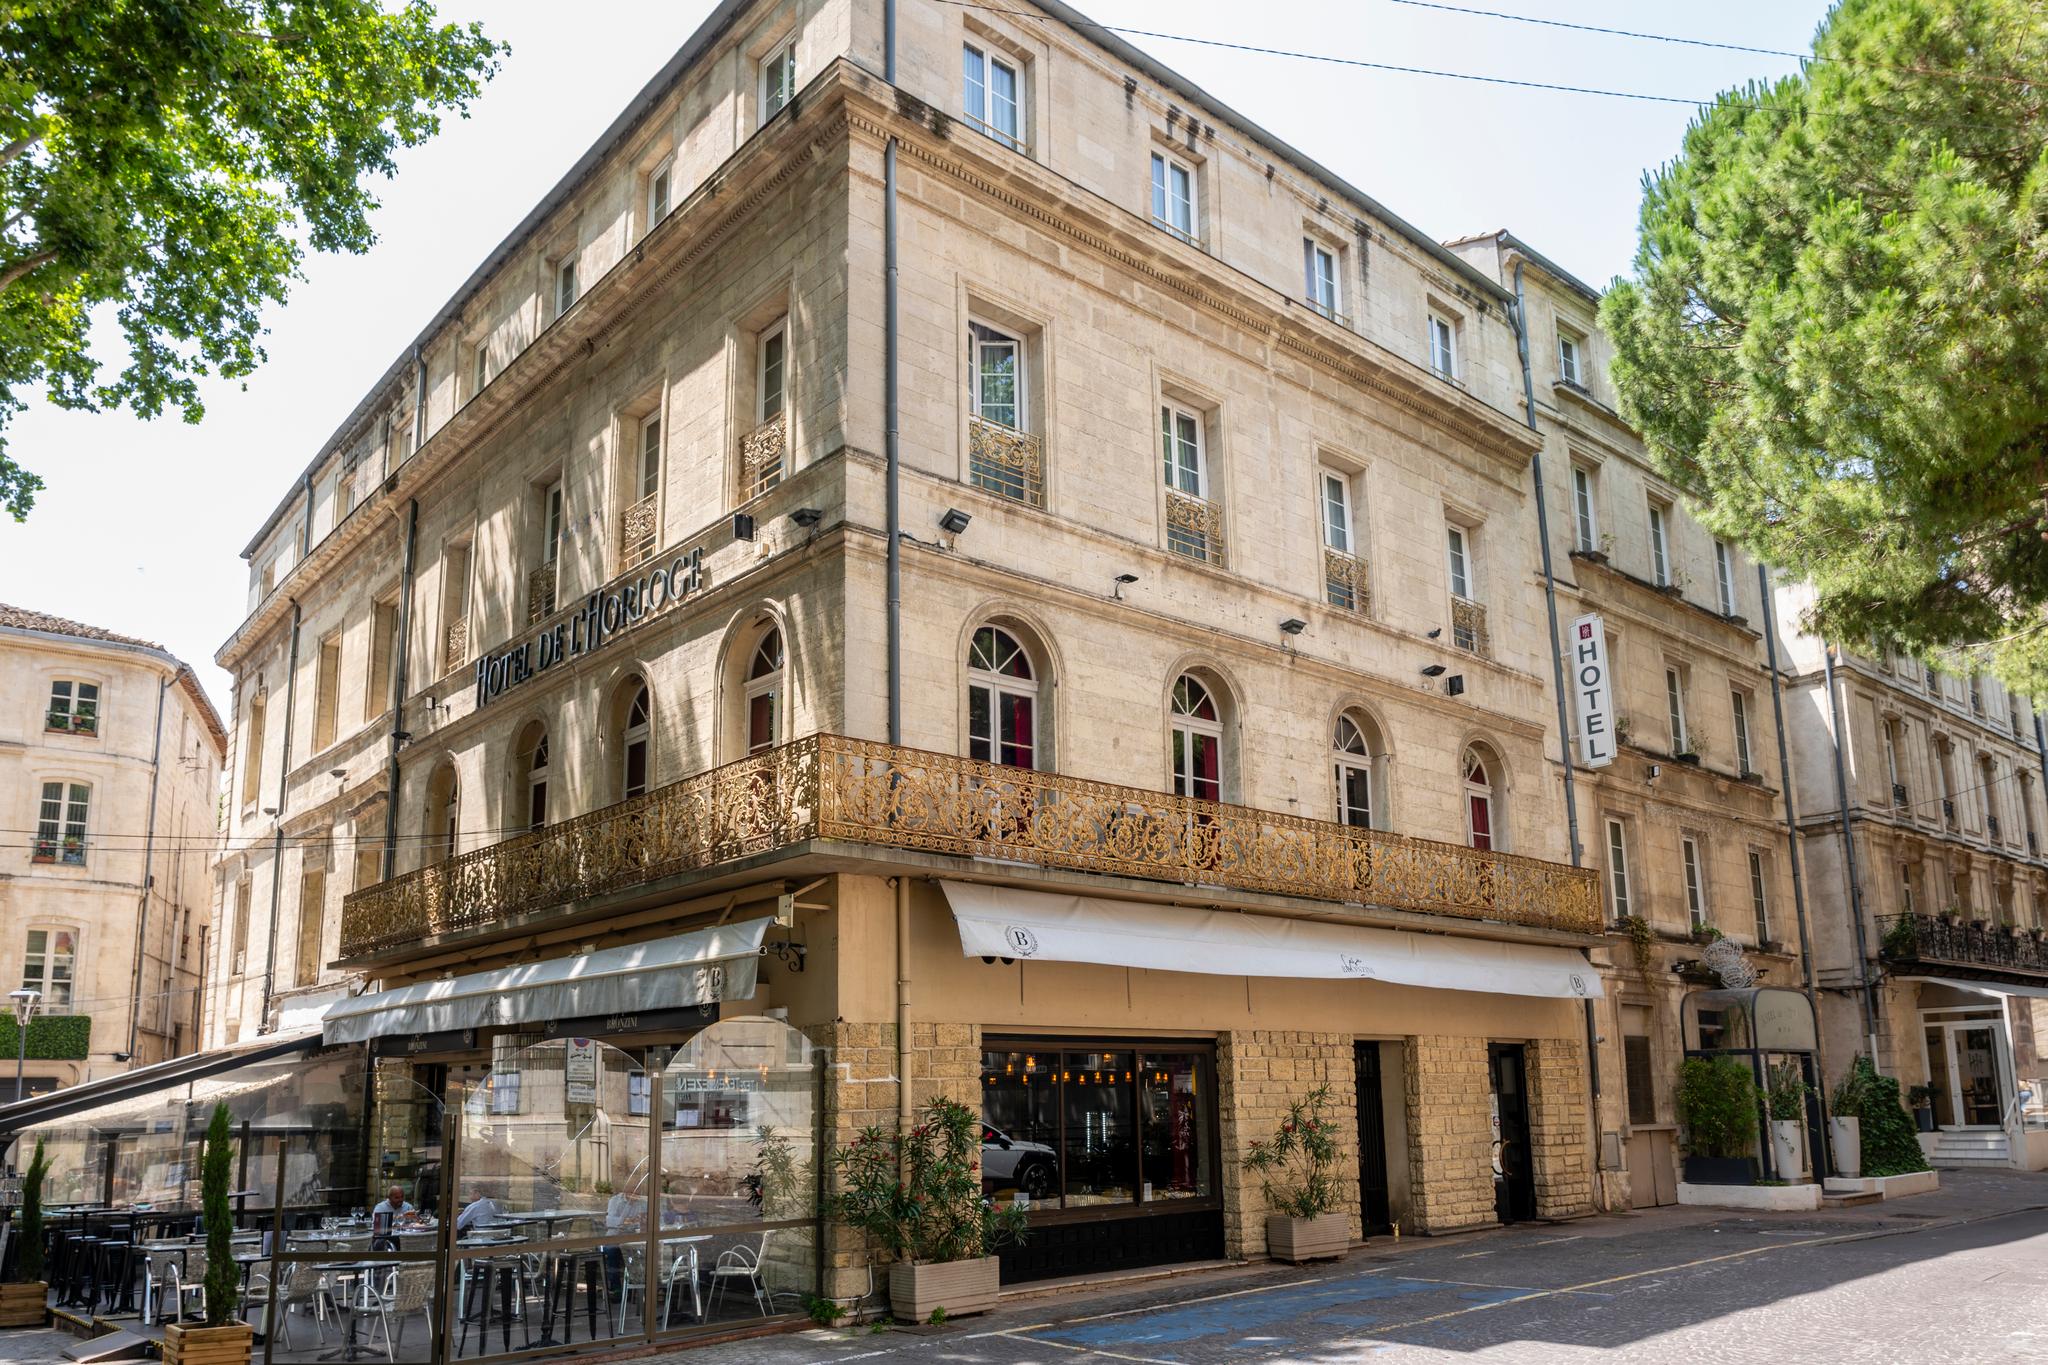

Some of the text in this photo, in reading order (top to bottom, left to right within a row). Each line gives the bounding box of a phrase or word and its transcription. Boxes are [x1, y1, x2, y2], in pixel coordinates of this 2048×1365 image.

[539, 624, 564, 672] DE
[570, 546, 704, 655] L'HORLOGE
[1578, 641, 1607, 759] HOTEL
